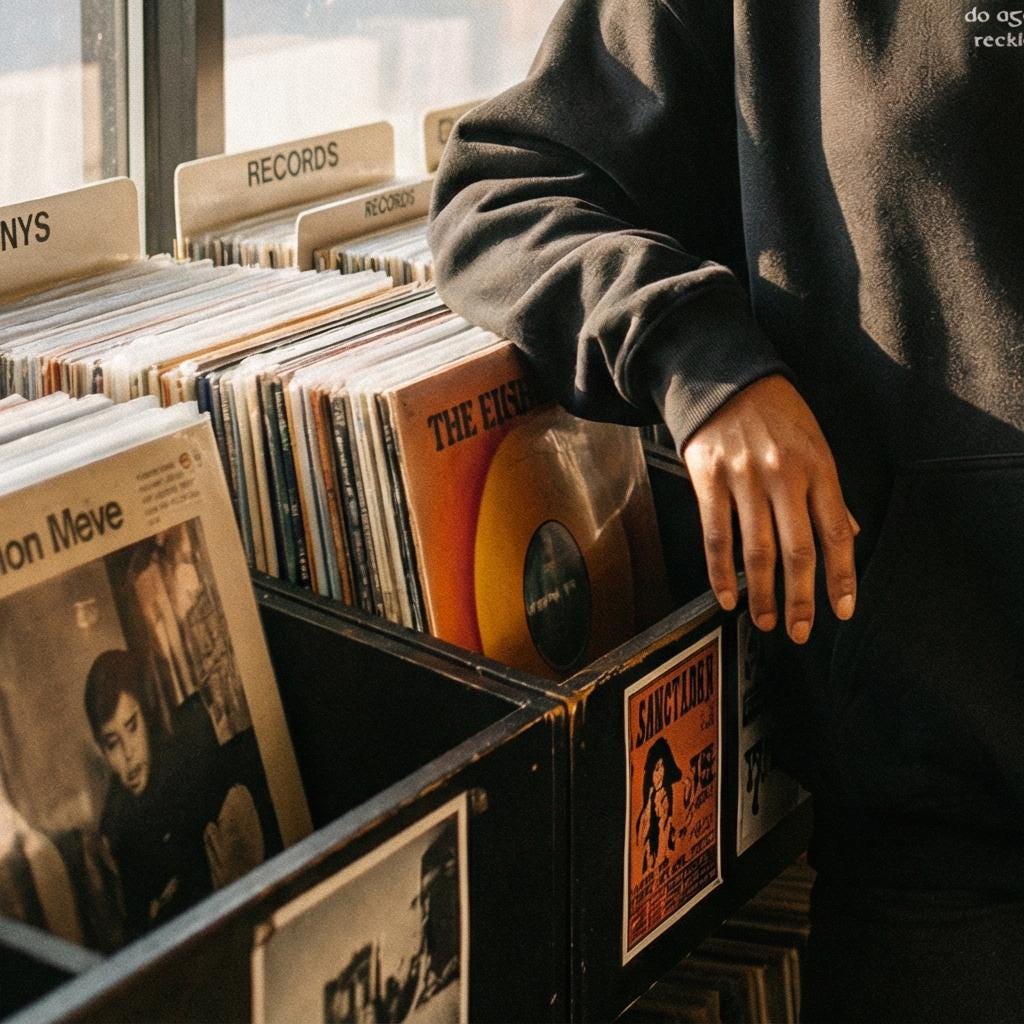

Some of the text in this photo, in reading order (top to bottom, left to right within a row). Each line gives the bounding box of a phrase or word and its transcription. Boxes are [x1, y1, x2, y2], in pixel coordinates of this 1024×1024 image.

[964, 6, 990, 23] do
[247, 141, 340, 187] RECORDS
[0, 211, 51, 251] NYS
[426, 399, 478, 452] THE
[46, 500, 124, 554] Meve
